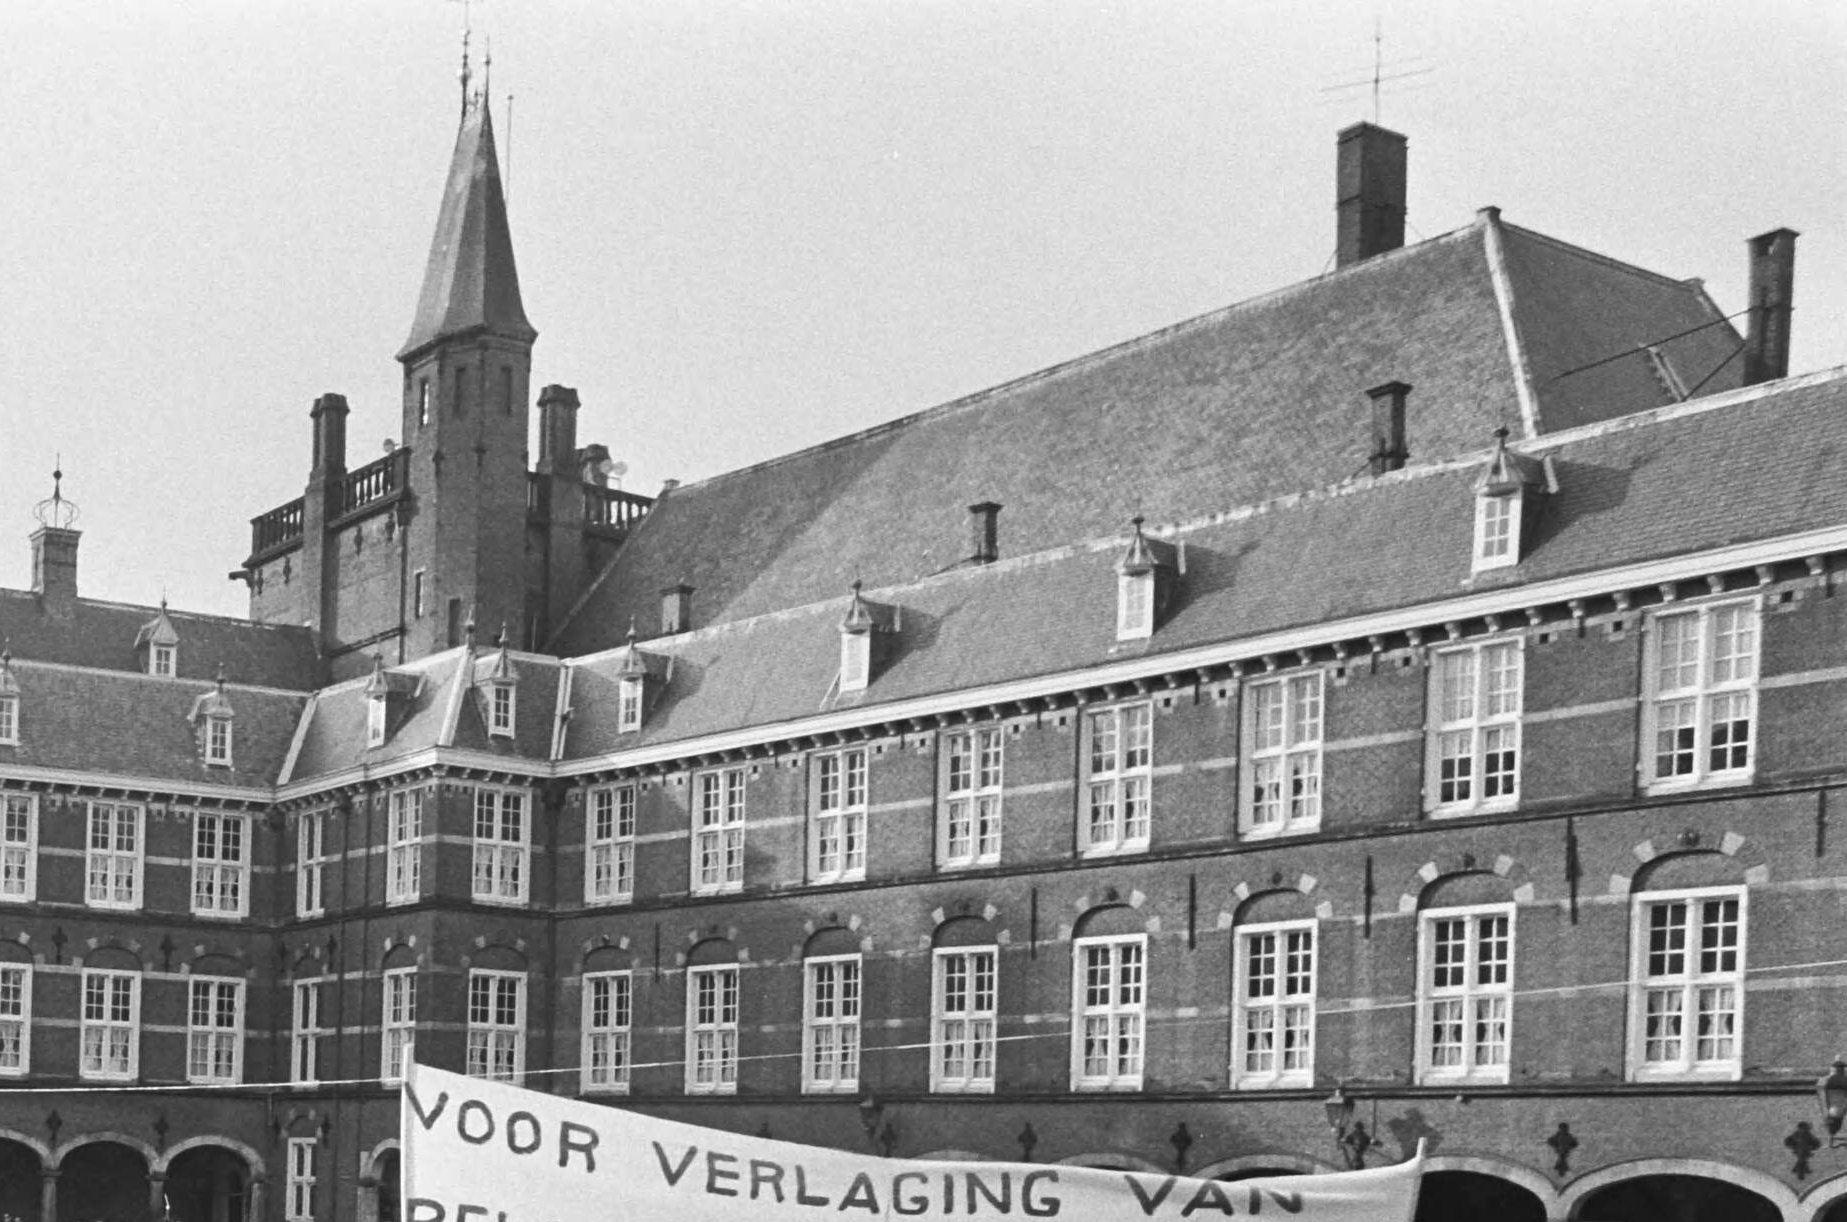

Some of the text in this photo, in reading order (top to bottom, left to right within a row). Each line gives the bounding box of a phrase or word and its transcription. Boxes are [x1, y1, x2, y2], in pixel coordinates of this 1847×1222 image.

[405, 1081, 1302, 1217] VOOR VERLAGING VAN
